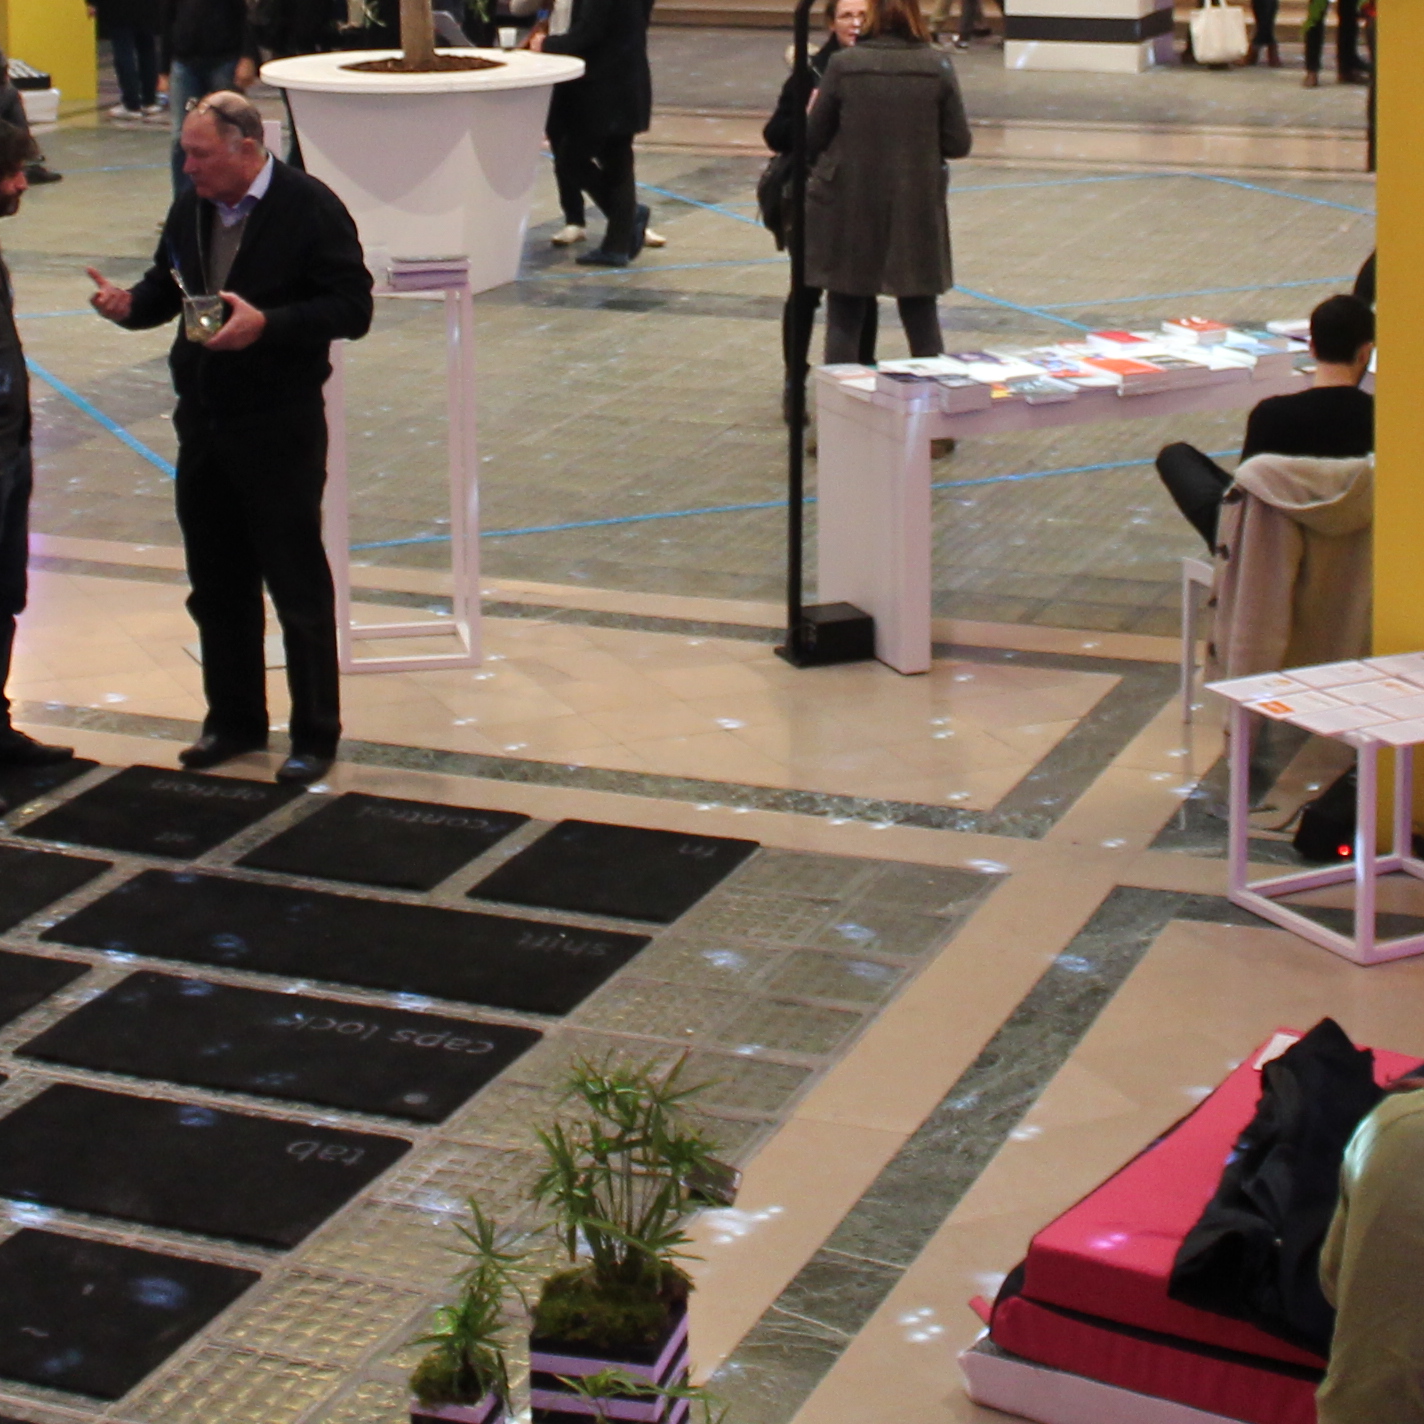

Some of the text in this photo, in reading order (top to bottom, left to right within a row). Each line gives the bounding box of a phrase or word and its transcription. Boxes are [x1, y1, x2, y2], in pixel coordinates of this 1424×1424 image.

[151, 779, 267, 801] option
[355, 803, 490, 831] control
[678, 839, 719, 858] fn
[517, 930, 606, 958] shift
[280, 1014, 496, 1054] caps lock
[286, 1137, 366, 1166] tab
